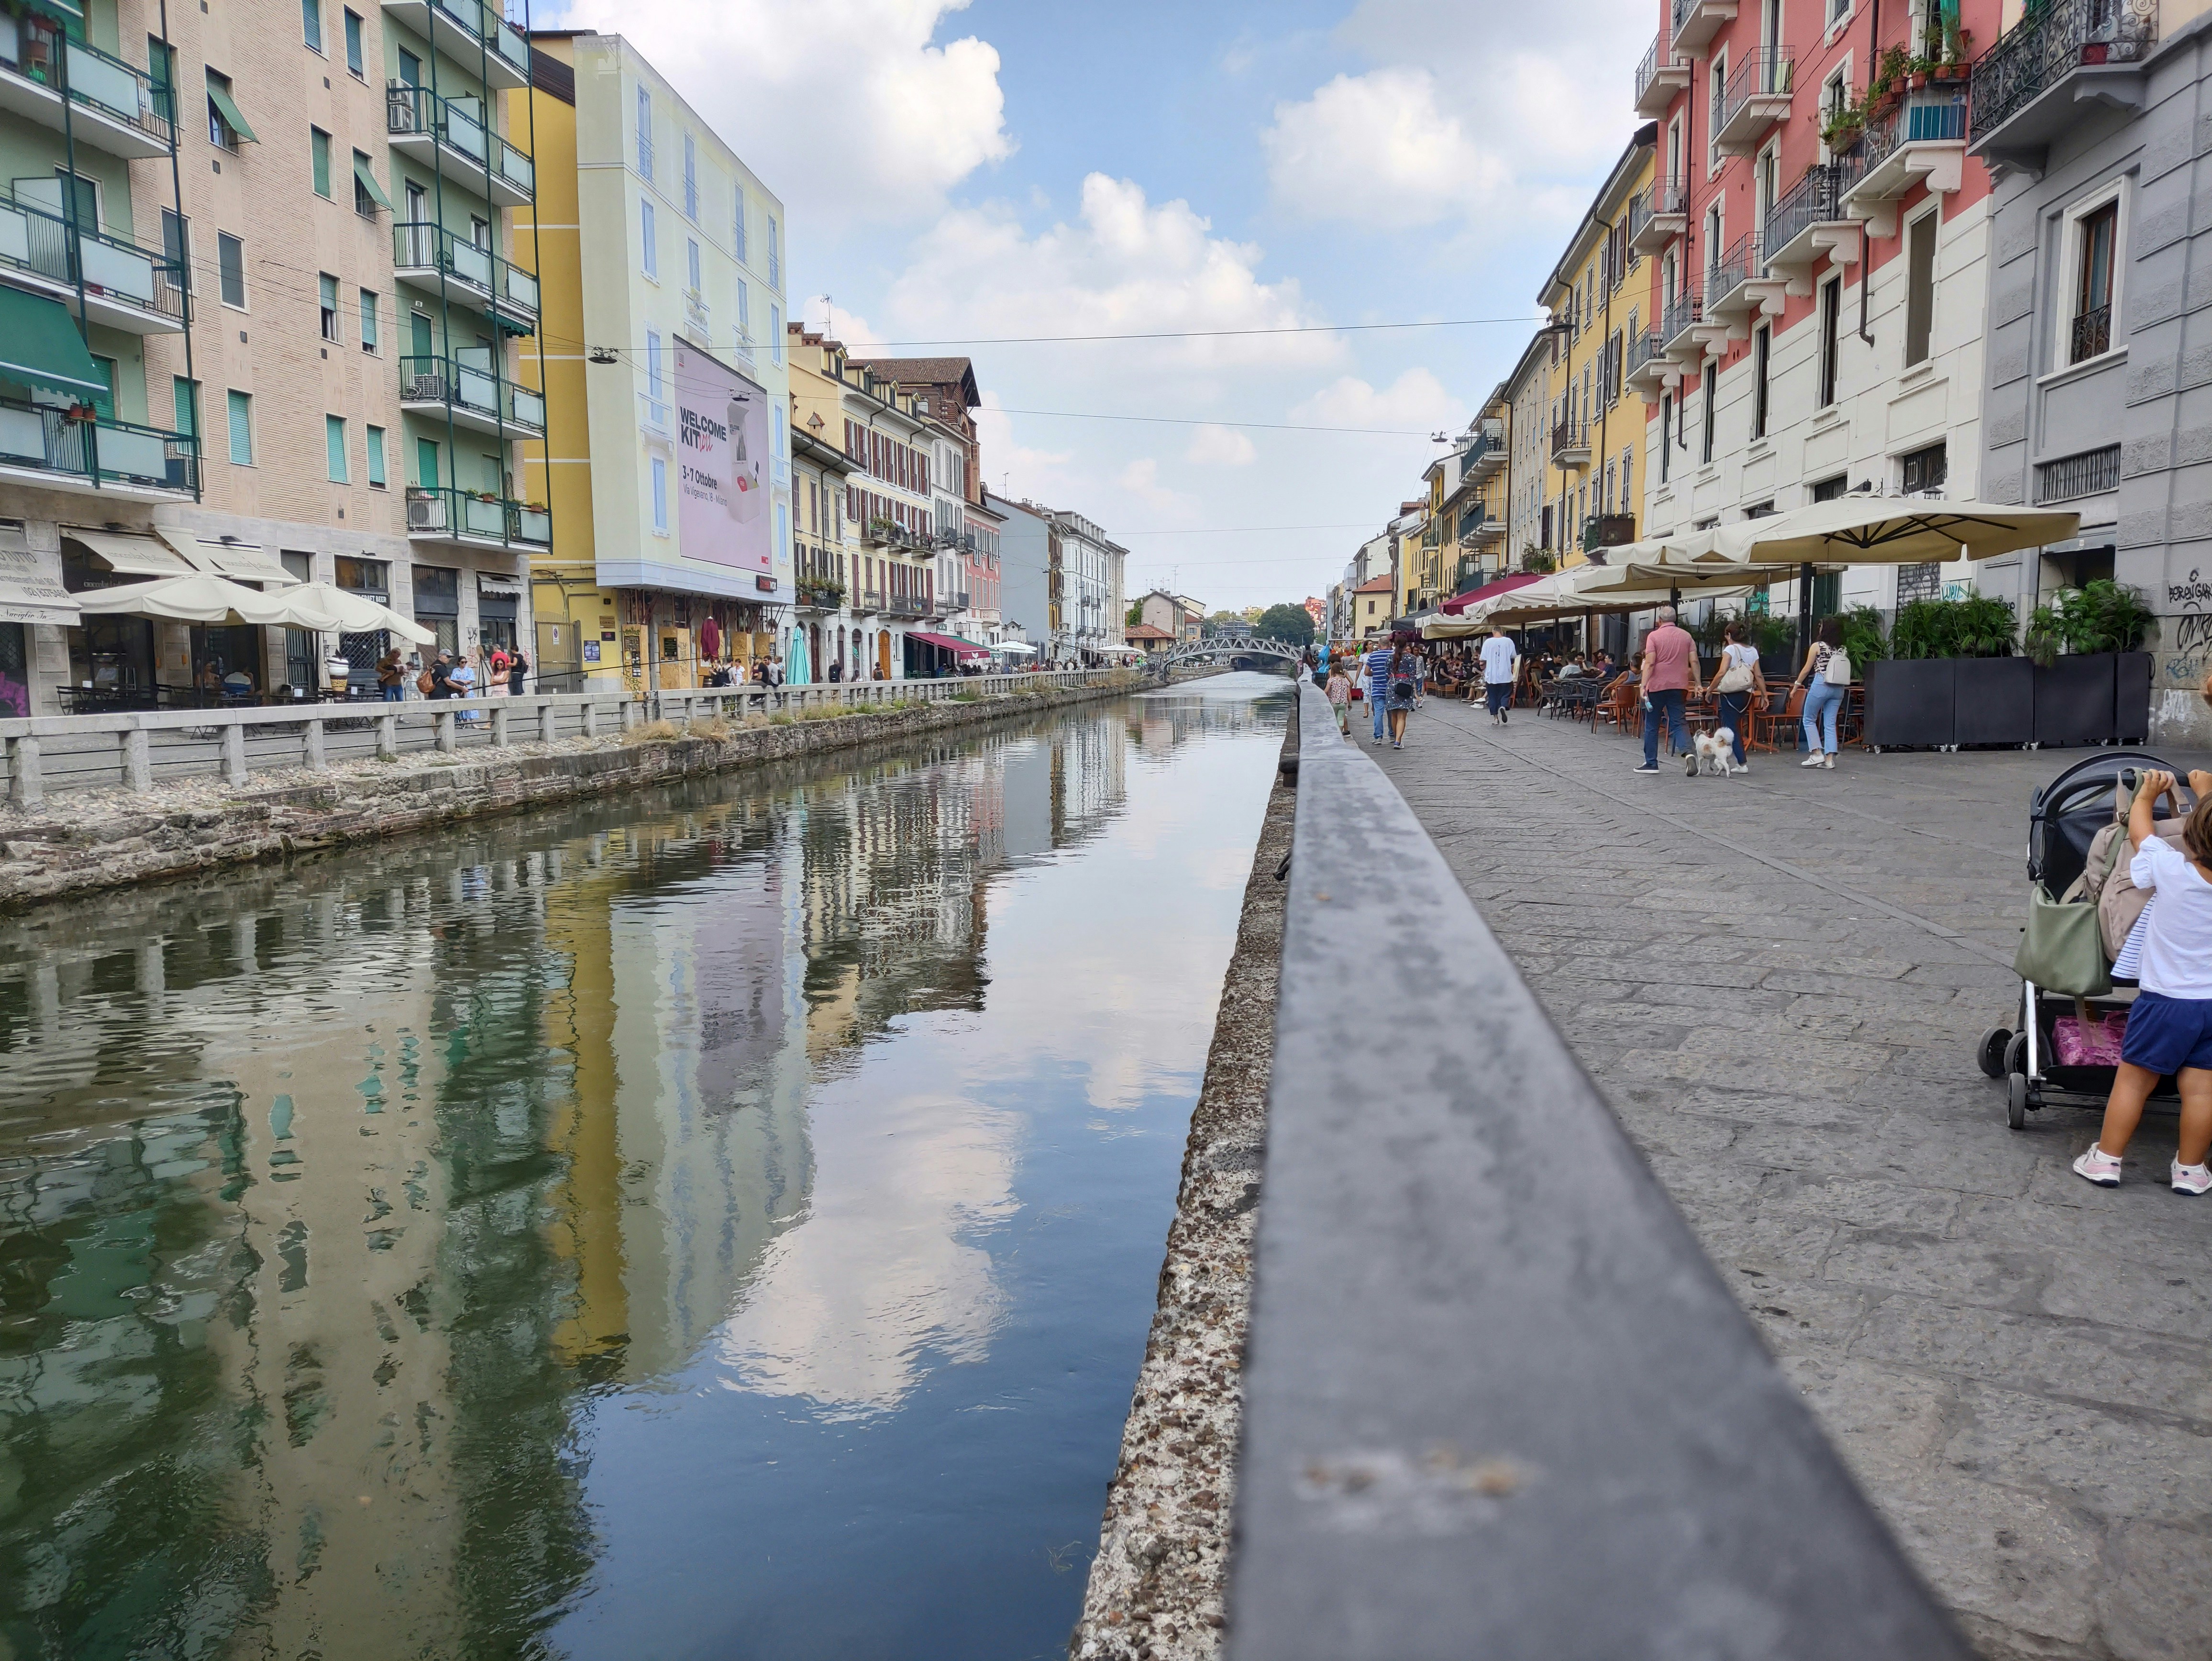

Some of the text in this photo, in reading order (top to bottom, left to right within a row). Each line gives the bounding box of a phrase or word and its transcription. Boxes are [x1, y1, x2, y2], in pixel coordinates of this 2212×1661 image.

[680, 406, 727, 442] WELCOME
[681, 424, 700, 449] KIT
[695, 469, 718, 490] Ottobre
[715, 494, 728, 507] Milano
[1, 550, 37, 564] TUTTO
[21, 587, 41, 599] (02)
